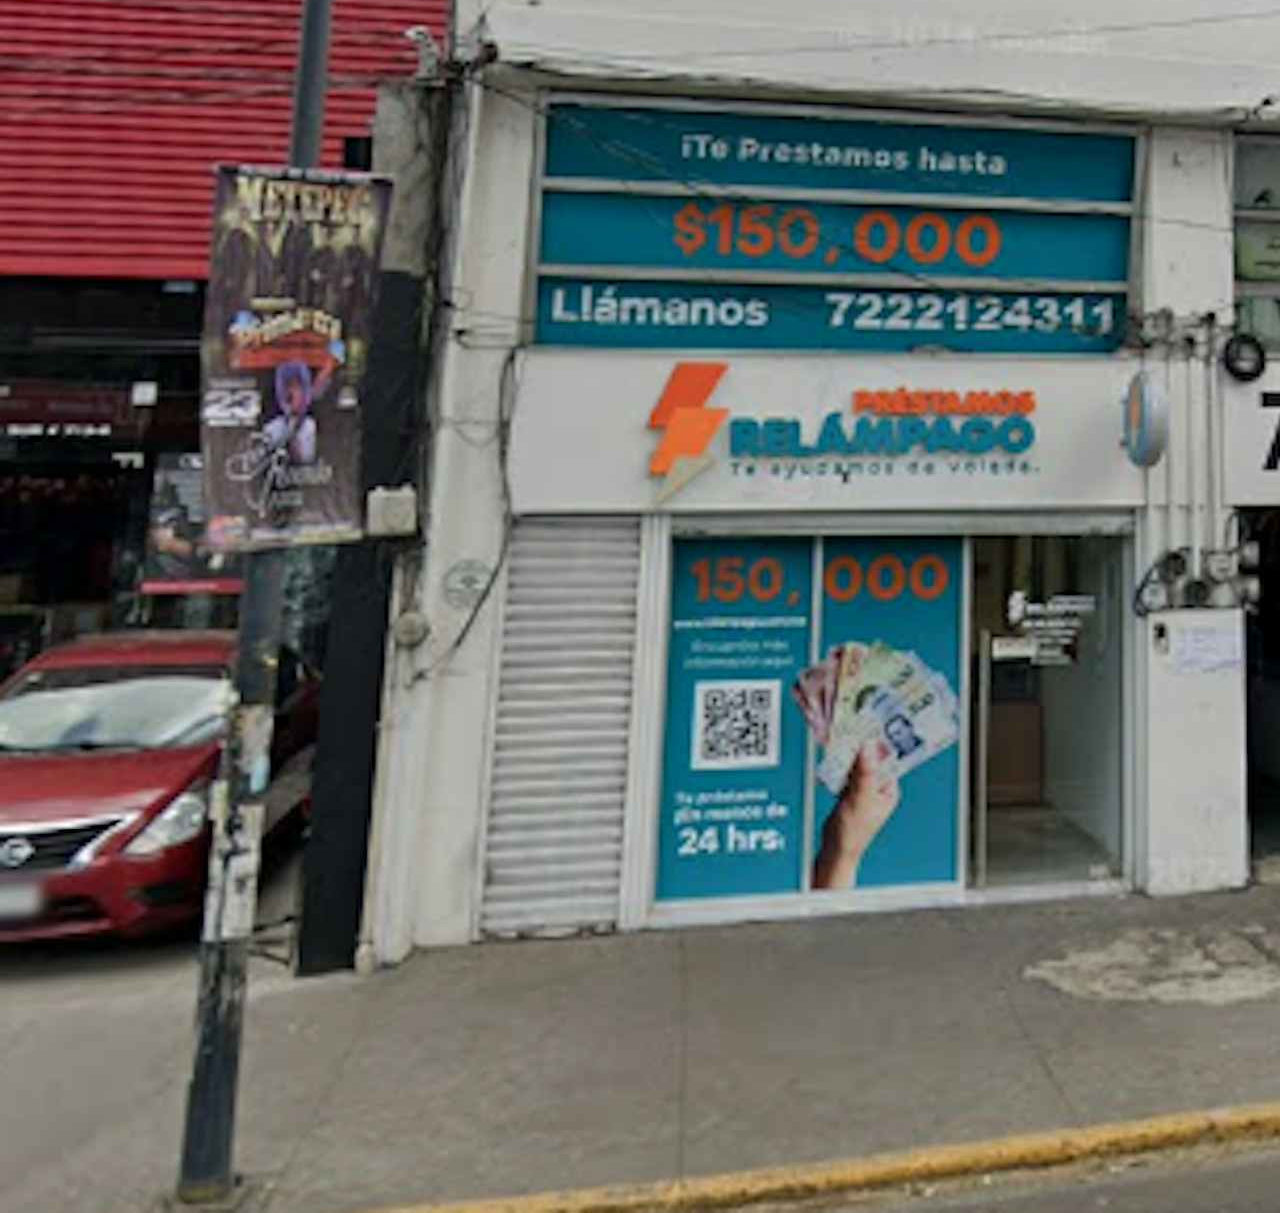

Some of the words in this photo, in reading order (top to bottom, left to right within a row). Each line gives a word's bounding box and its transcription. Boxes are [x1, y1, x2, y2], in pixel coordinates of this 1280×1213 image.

[739, 136, 911, 172] Prestamos
[919, 149, 1008, 177] hasta
[552, 286, 769, 328] Llámanos
[826, 291, 1115, 333] 7222124311
[852, 387, 1037, 416] PRÉSTAMOS
[729, 412, 1037, 458] RELÁMPAGO
[730, 462, 756, 476] Te
[907, 460, 935, 475] de
[677, 826, 720, 857] 24
